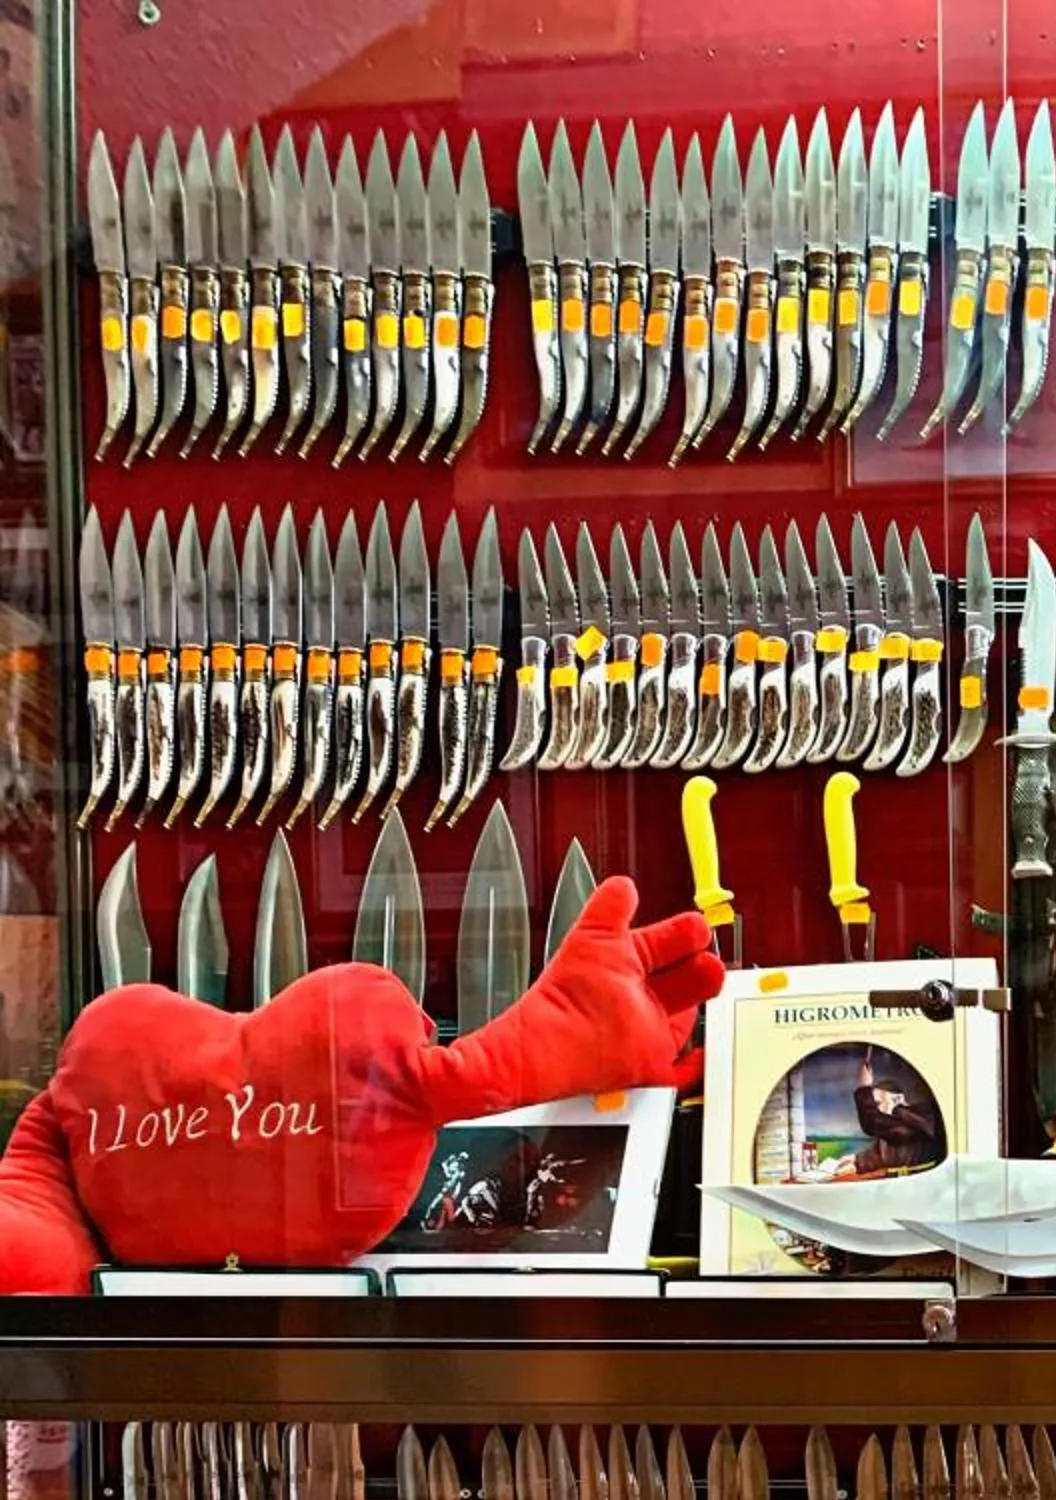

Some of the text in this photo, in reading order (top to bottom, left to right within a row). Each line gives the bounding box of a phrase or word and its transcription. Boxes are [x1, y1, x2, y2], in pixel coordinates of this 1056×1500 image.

[88, 1084, 324, 1156] I Love You
